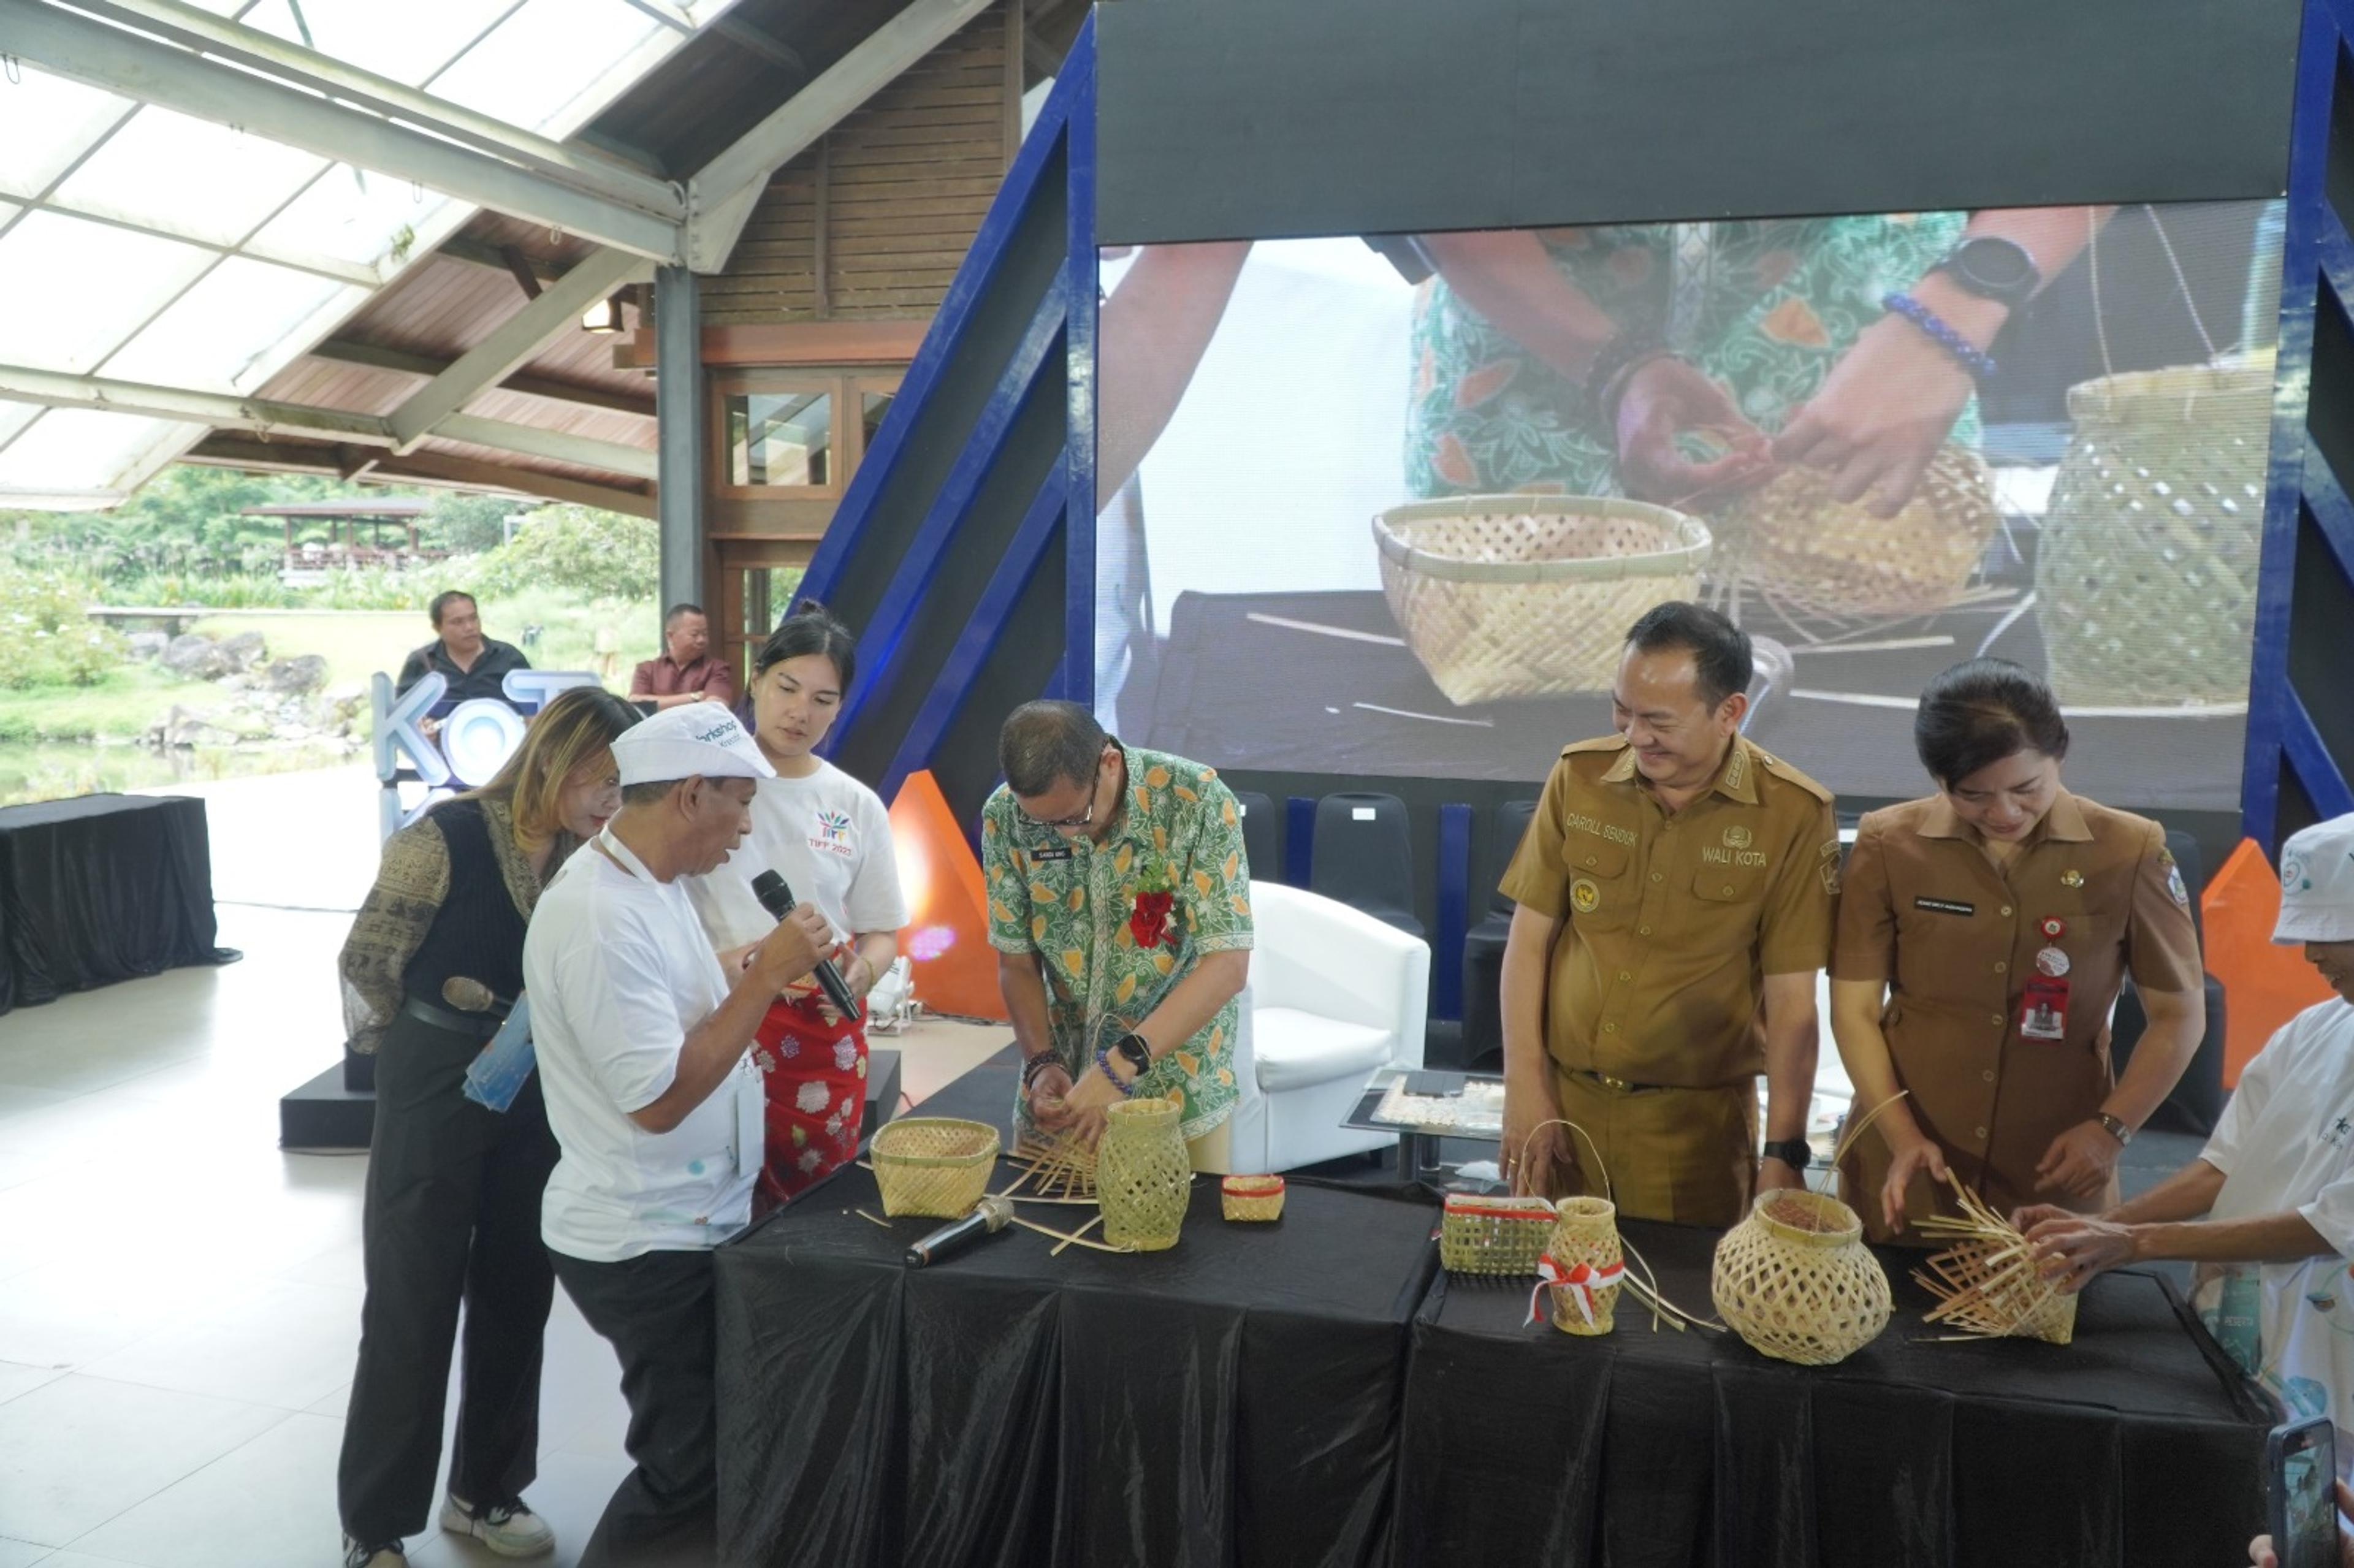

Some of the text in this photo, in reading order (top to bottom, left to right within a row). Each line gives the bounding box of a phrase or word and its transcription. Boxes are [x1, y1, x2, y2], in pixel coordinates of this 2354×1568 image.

[1567, 813, 1601, 835] CAROLL
[1702, 847, 1767, 867] WALI KOTA
